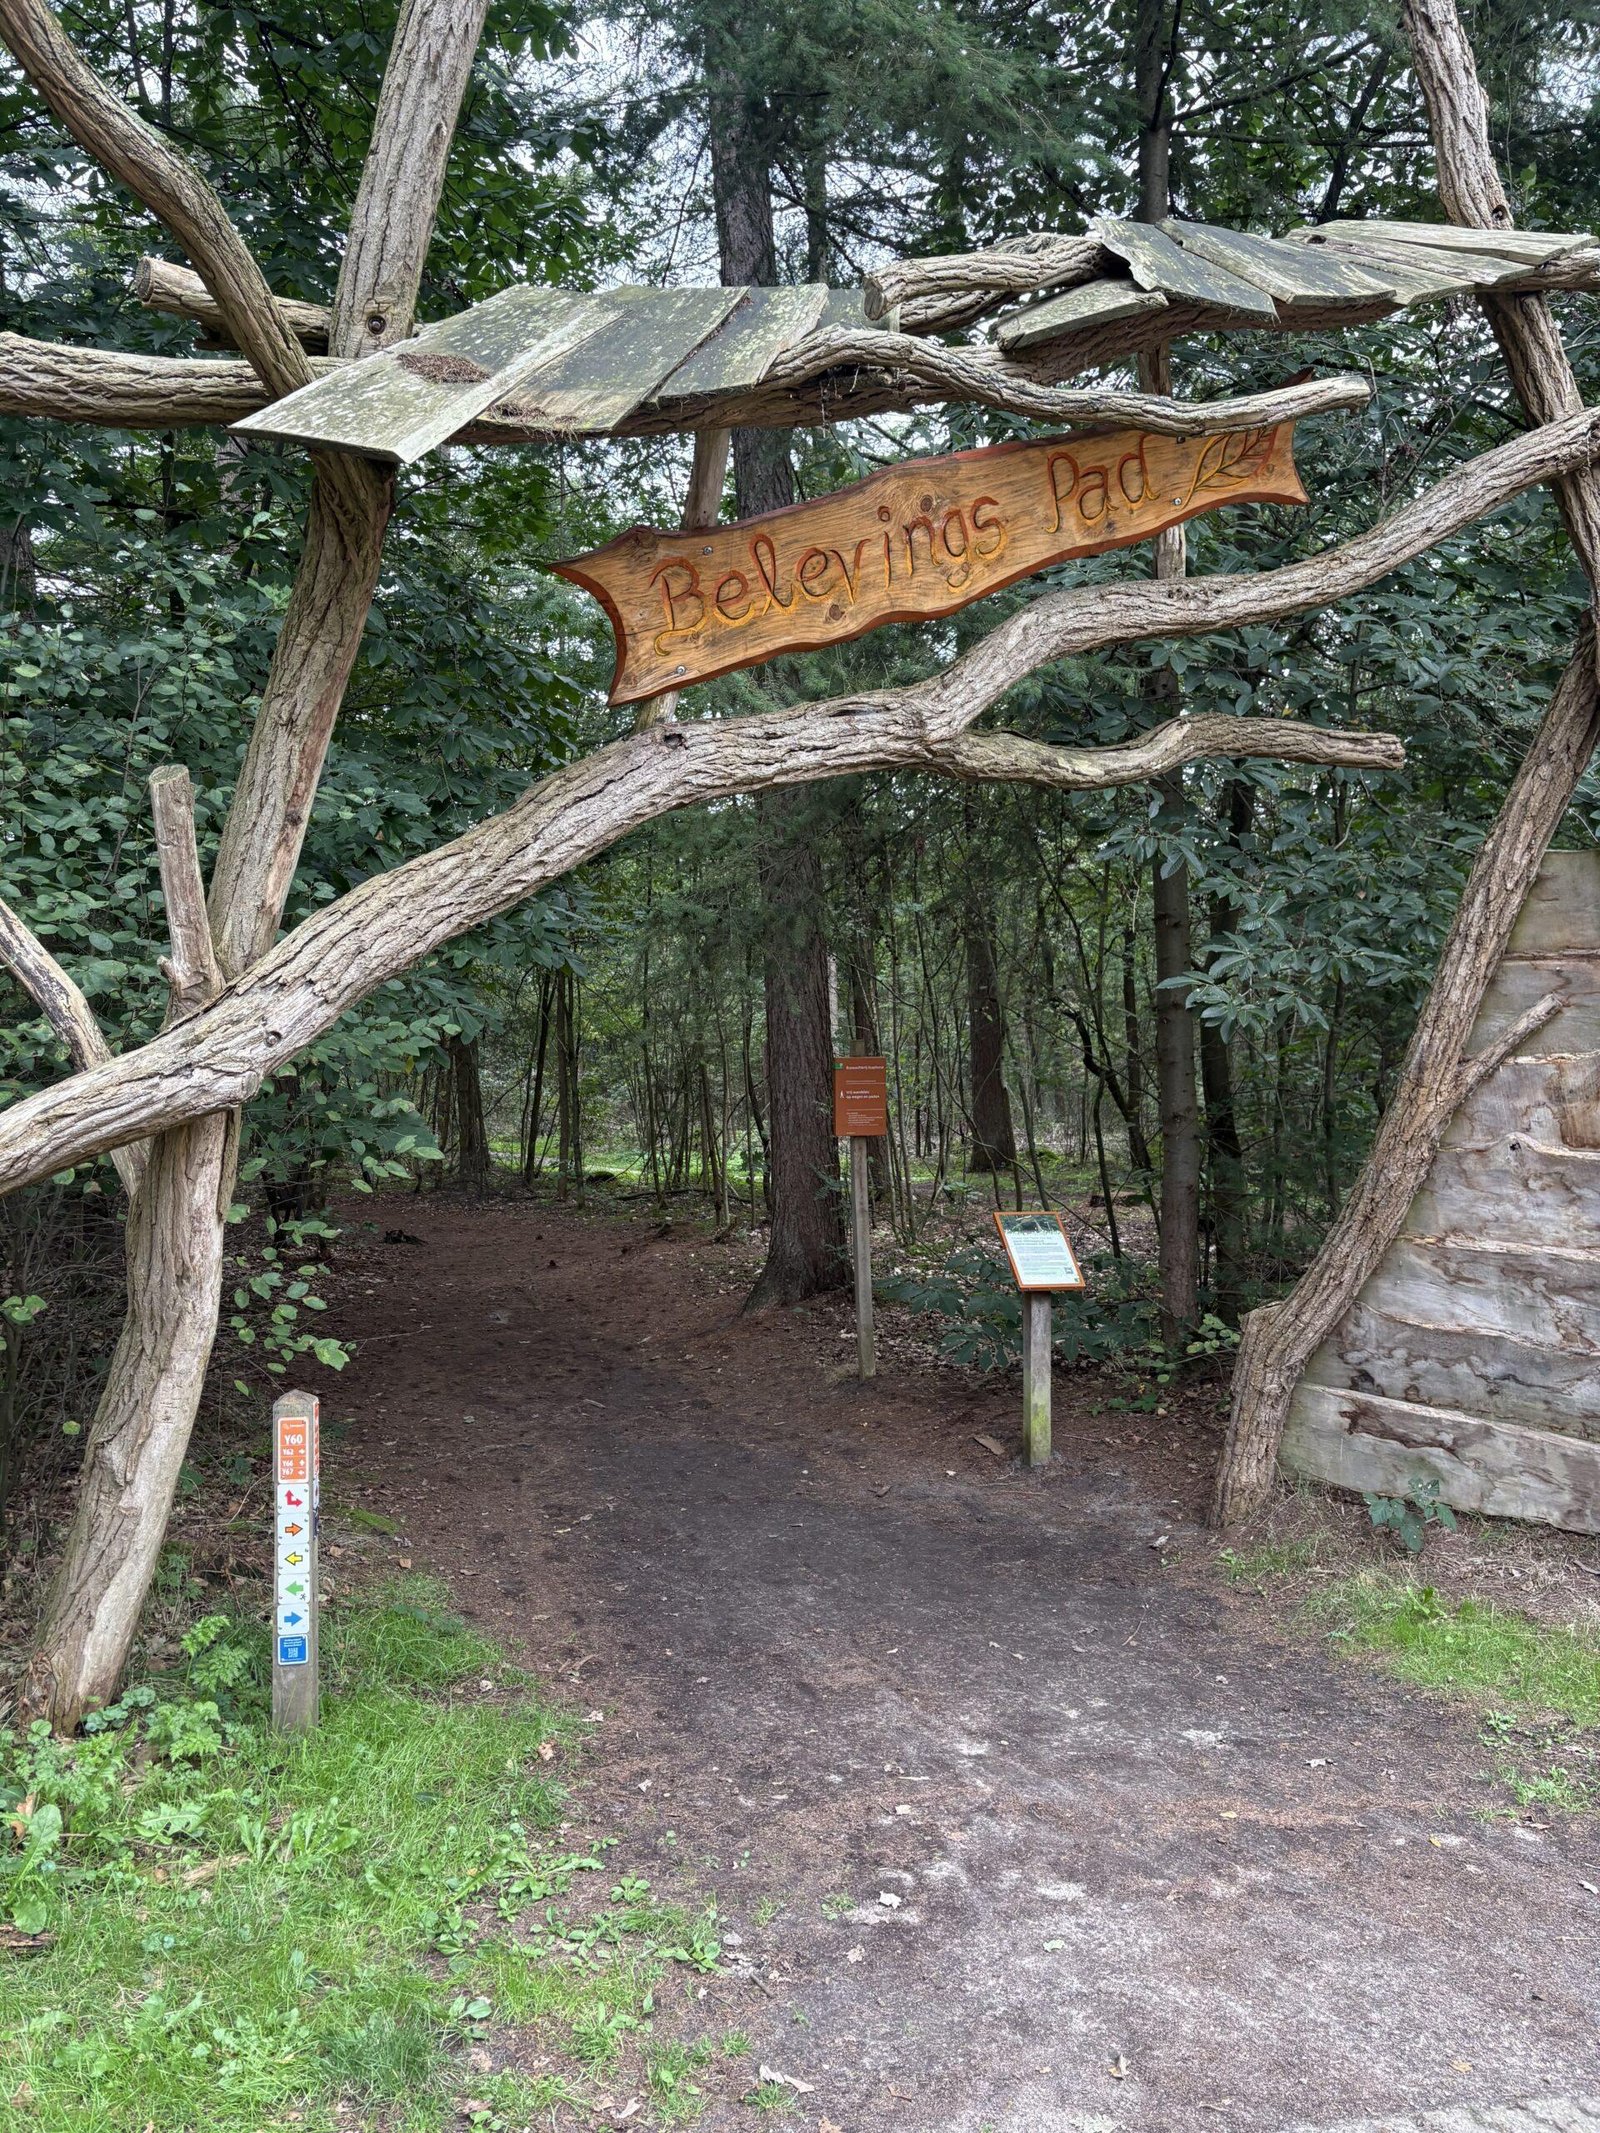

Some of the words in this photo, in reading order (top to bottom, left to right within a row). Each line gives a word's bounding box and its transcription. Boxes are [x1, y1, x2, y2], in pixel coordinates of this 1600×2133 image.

[648, 495, 1009, 657] Belevings
[1045, 433, 1161, 536] Pad
[284, 1434, 303, 1445] Y60
